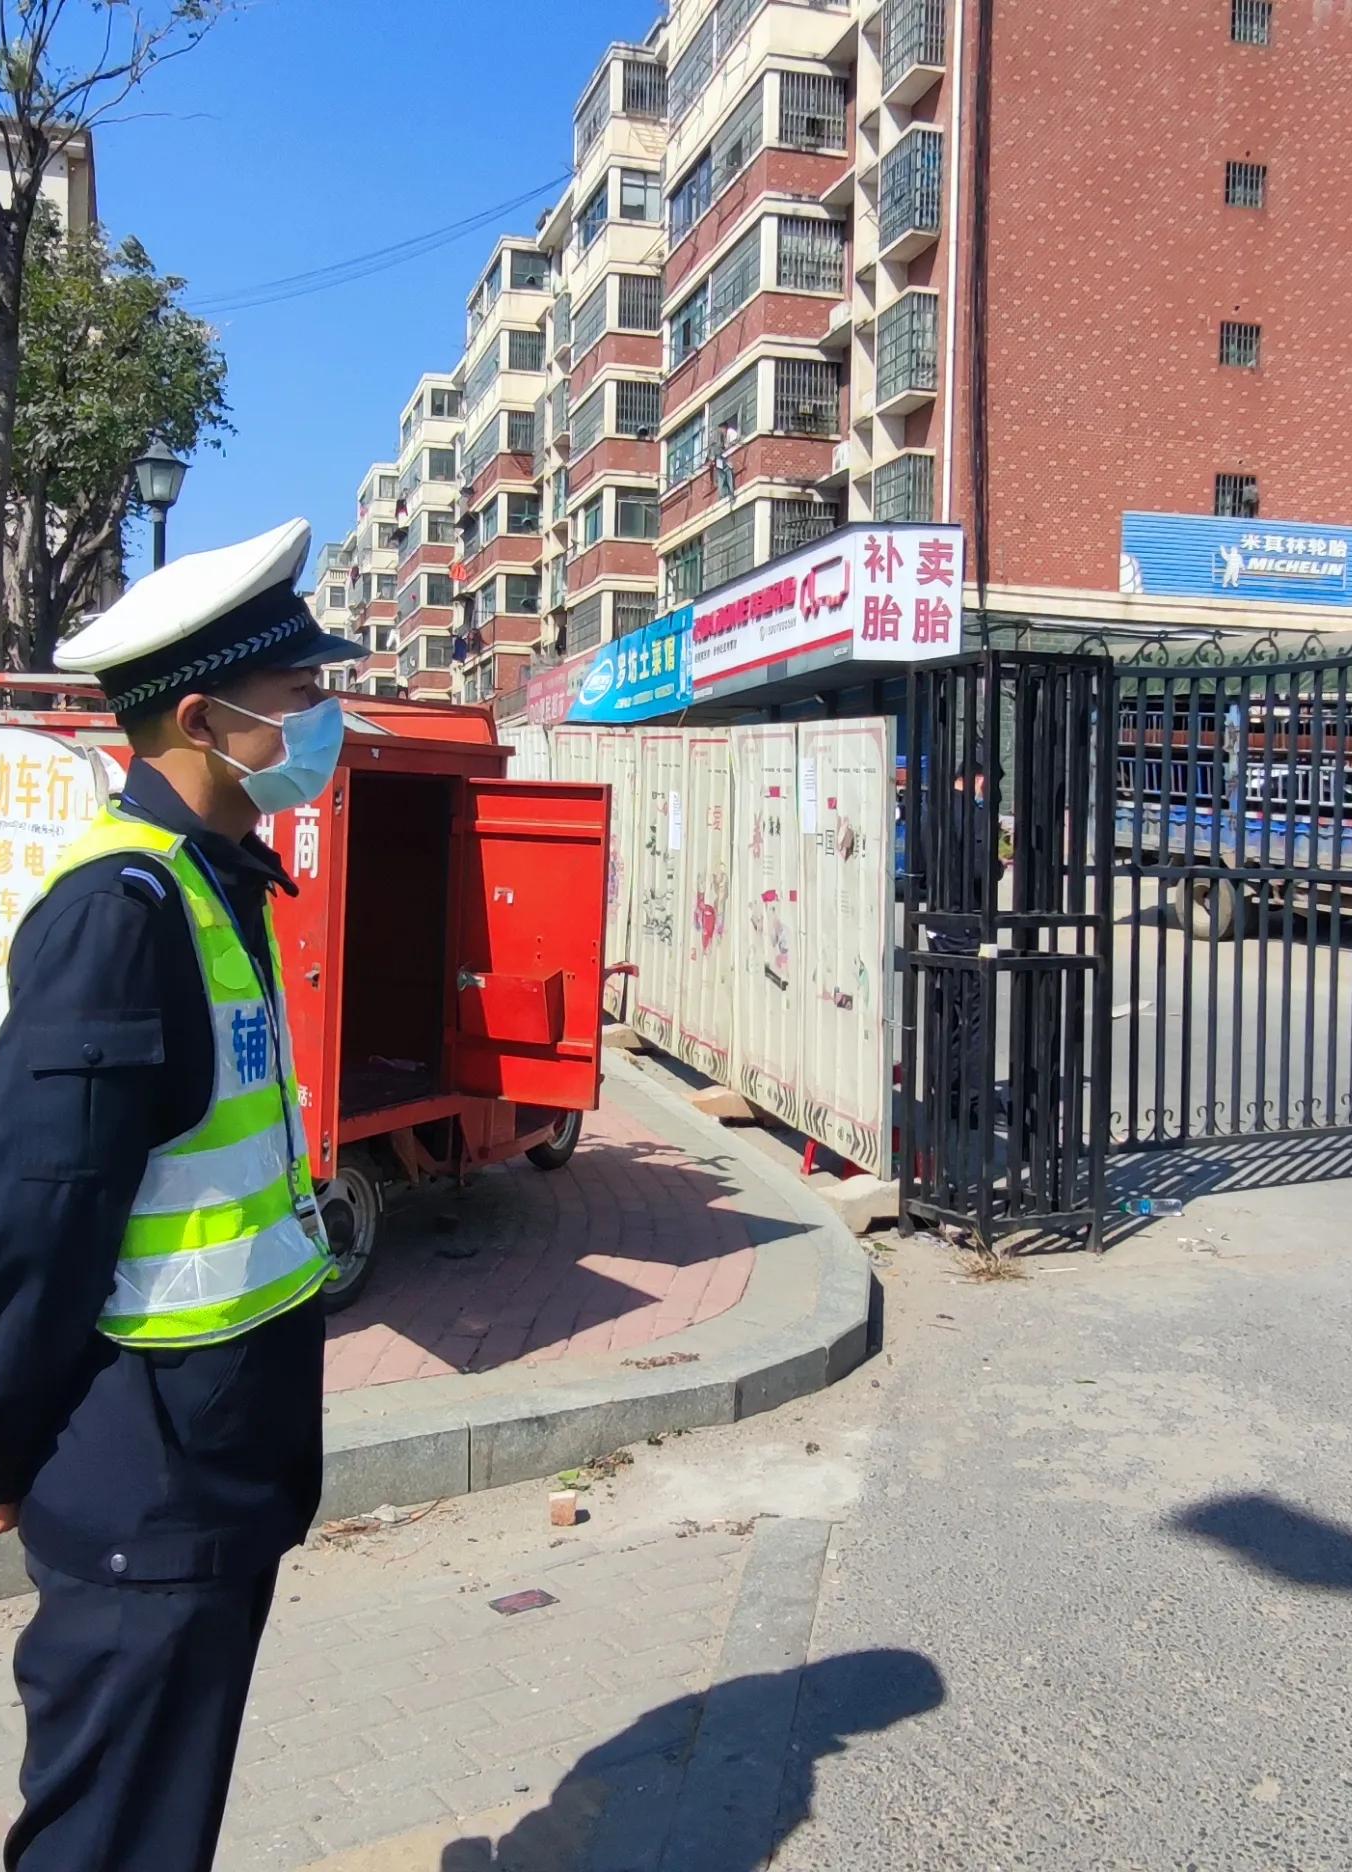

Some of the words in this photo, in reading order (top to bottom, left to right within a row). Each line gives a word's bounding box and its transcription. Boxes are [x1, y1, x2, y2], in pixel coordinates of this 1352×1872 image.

[1240, 533, 1347, 557] 米其林轮胎
[1248, 557, 1344, 576] MICHELIN
[232, 1006, 267, 1085] 辅
